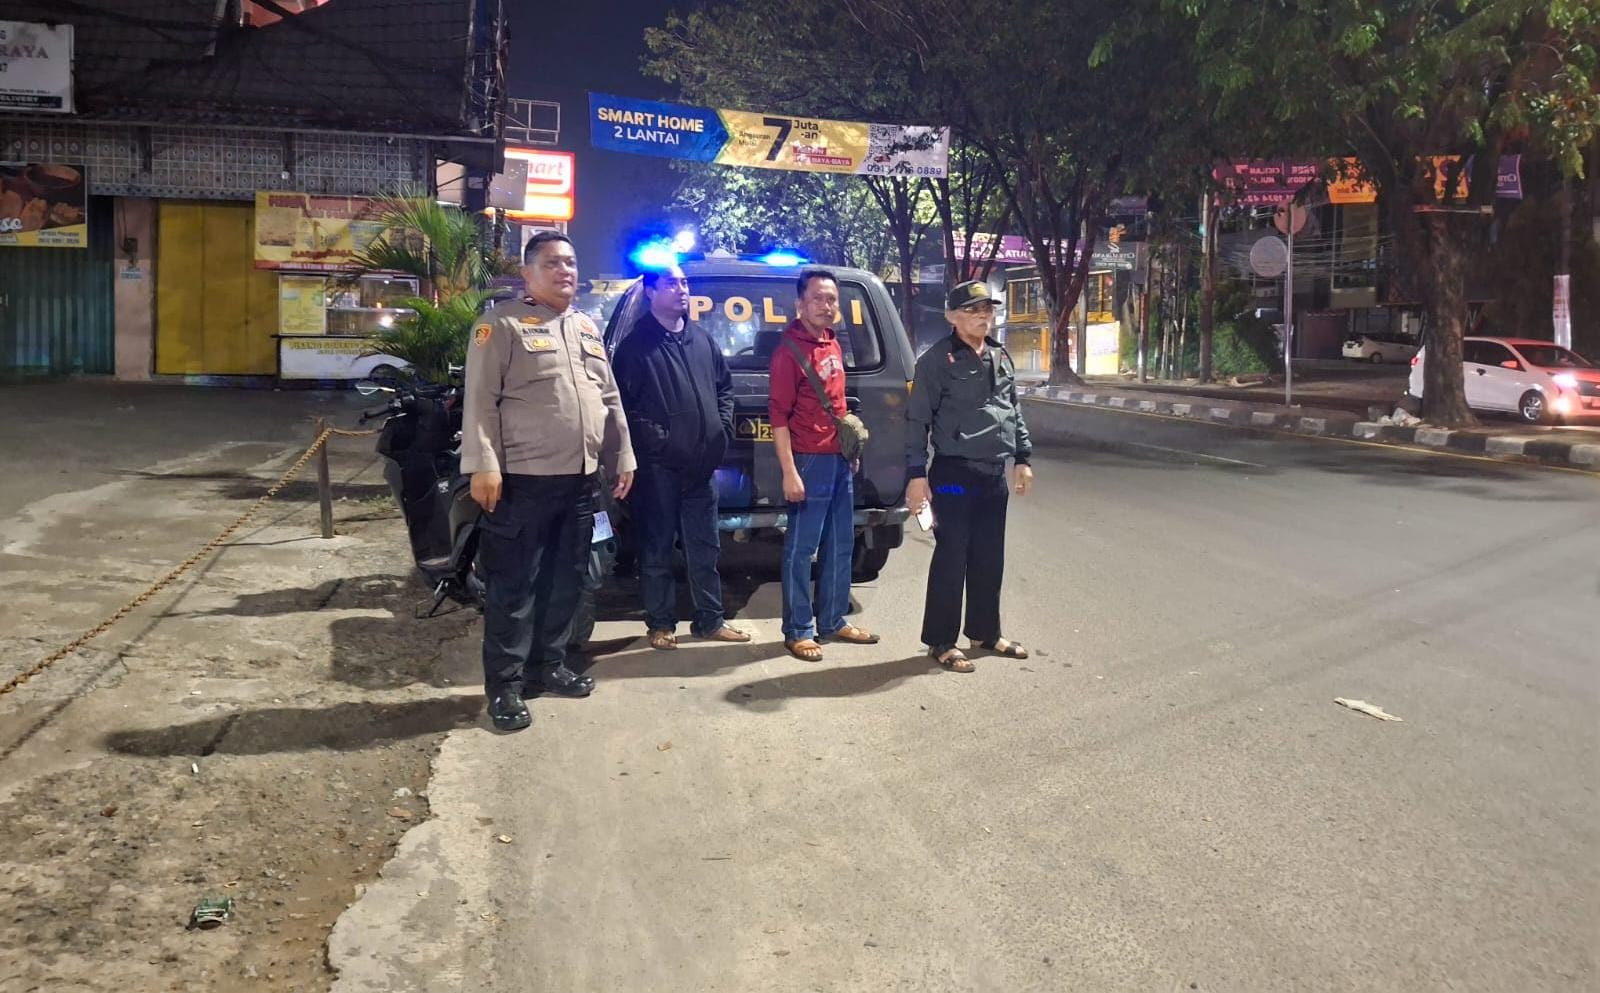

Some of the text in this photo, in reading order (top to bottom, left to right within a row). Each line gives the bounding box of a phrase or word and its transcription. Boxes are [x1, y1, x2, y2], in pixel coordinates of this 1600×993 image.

[597, 107, 705, 133] SMART HOME
[794, 120, 819, 131] Juta
[613, 125, 680, 145] 2 LANTAI
[763, 117, 793, 161] 7
[690, 296, 863, 326] POLI
